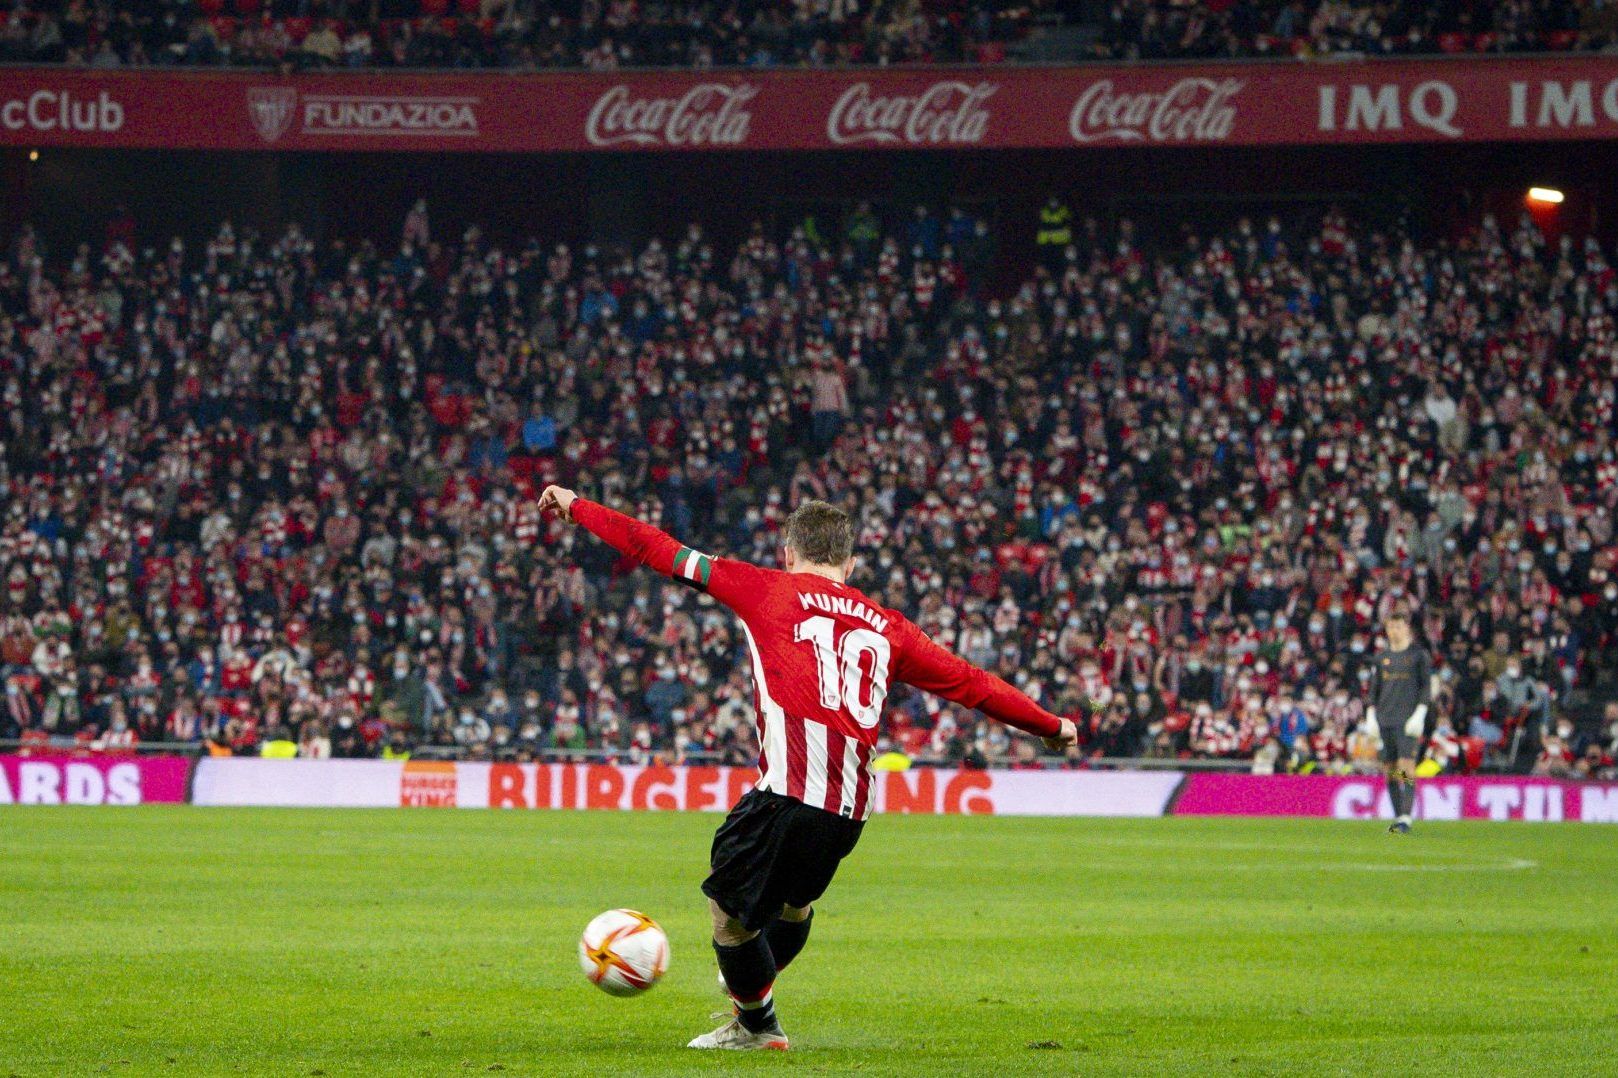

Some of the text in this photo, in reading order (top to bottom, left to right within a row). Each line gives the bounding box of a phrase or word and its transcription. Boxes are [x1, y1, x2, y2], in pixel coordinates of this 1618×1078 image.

[304, 102, 478, 130] FUNDAZIOA
[1317, 80, 1463, 138] IMQ
[794, 615, 891, 729] 10
